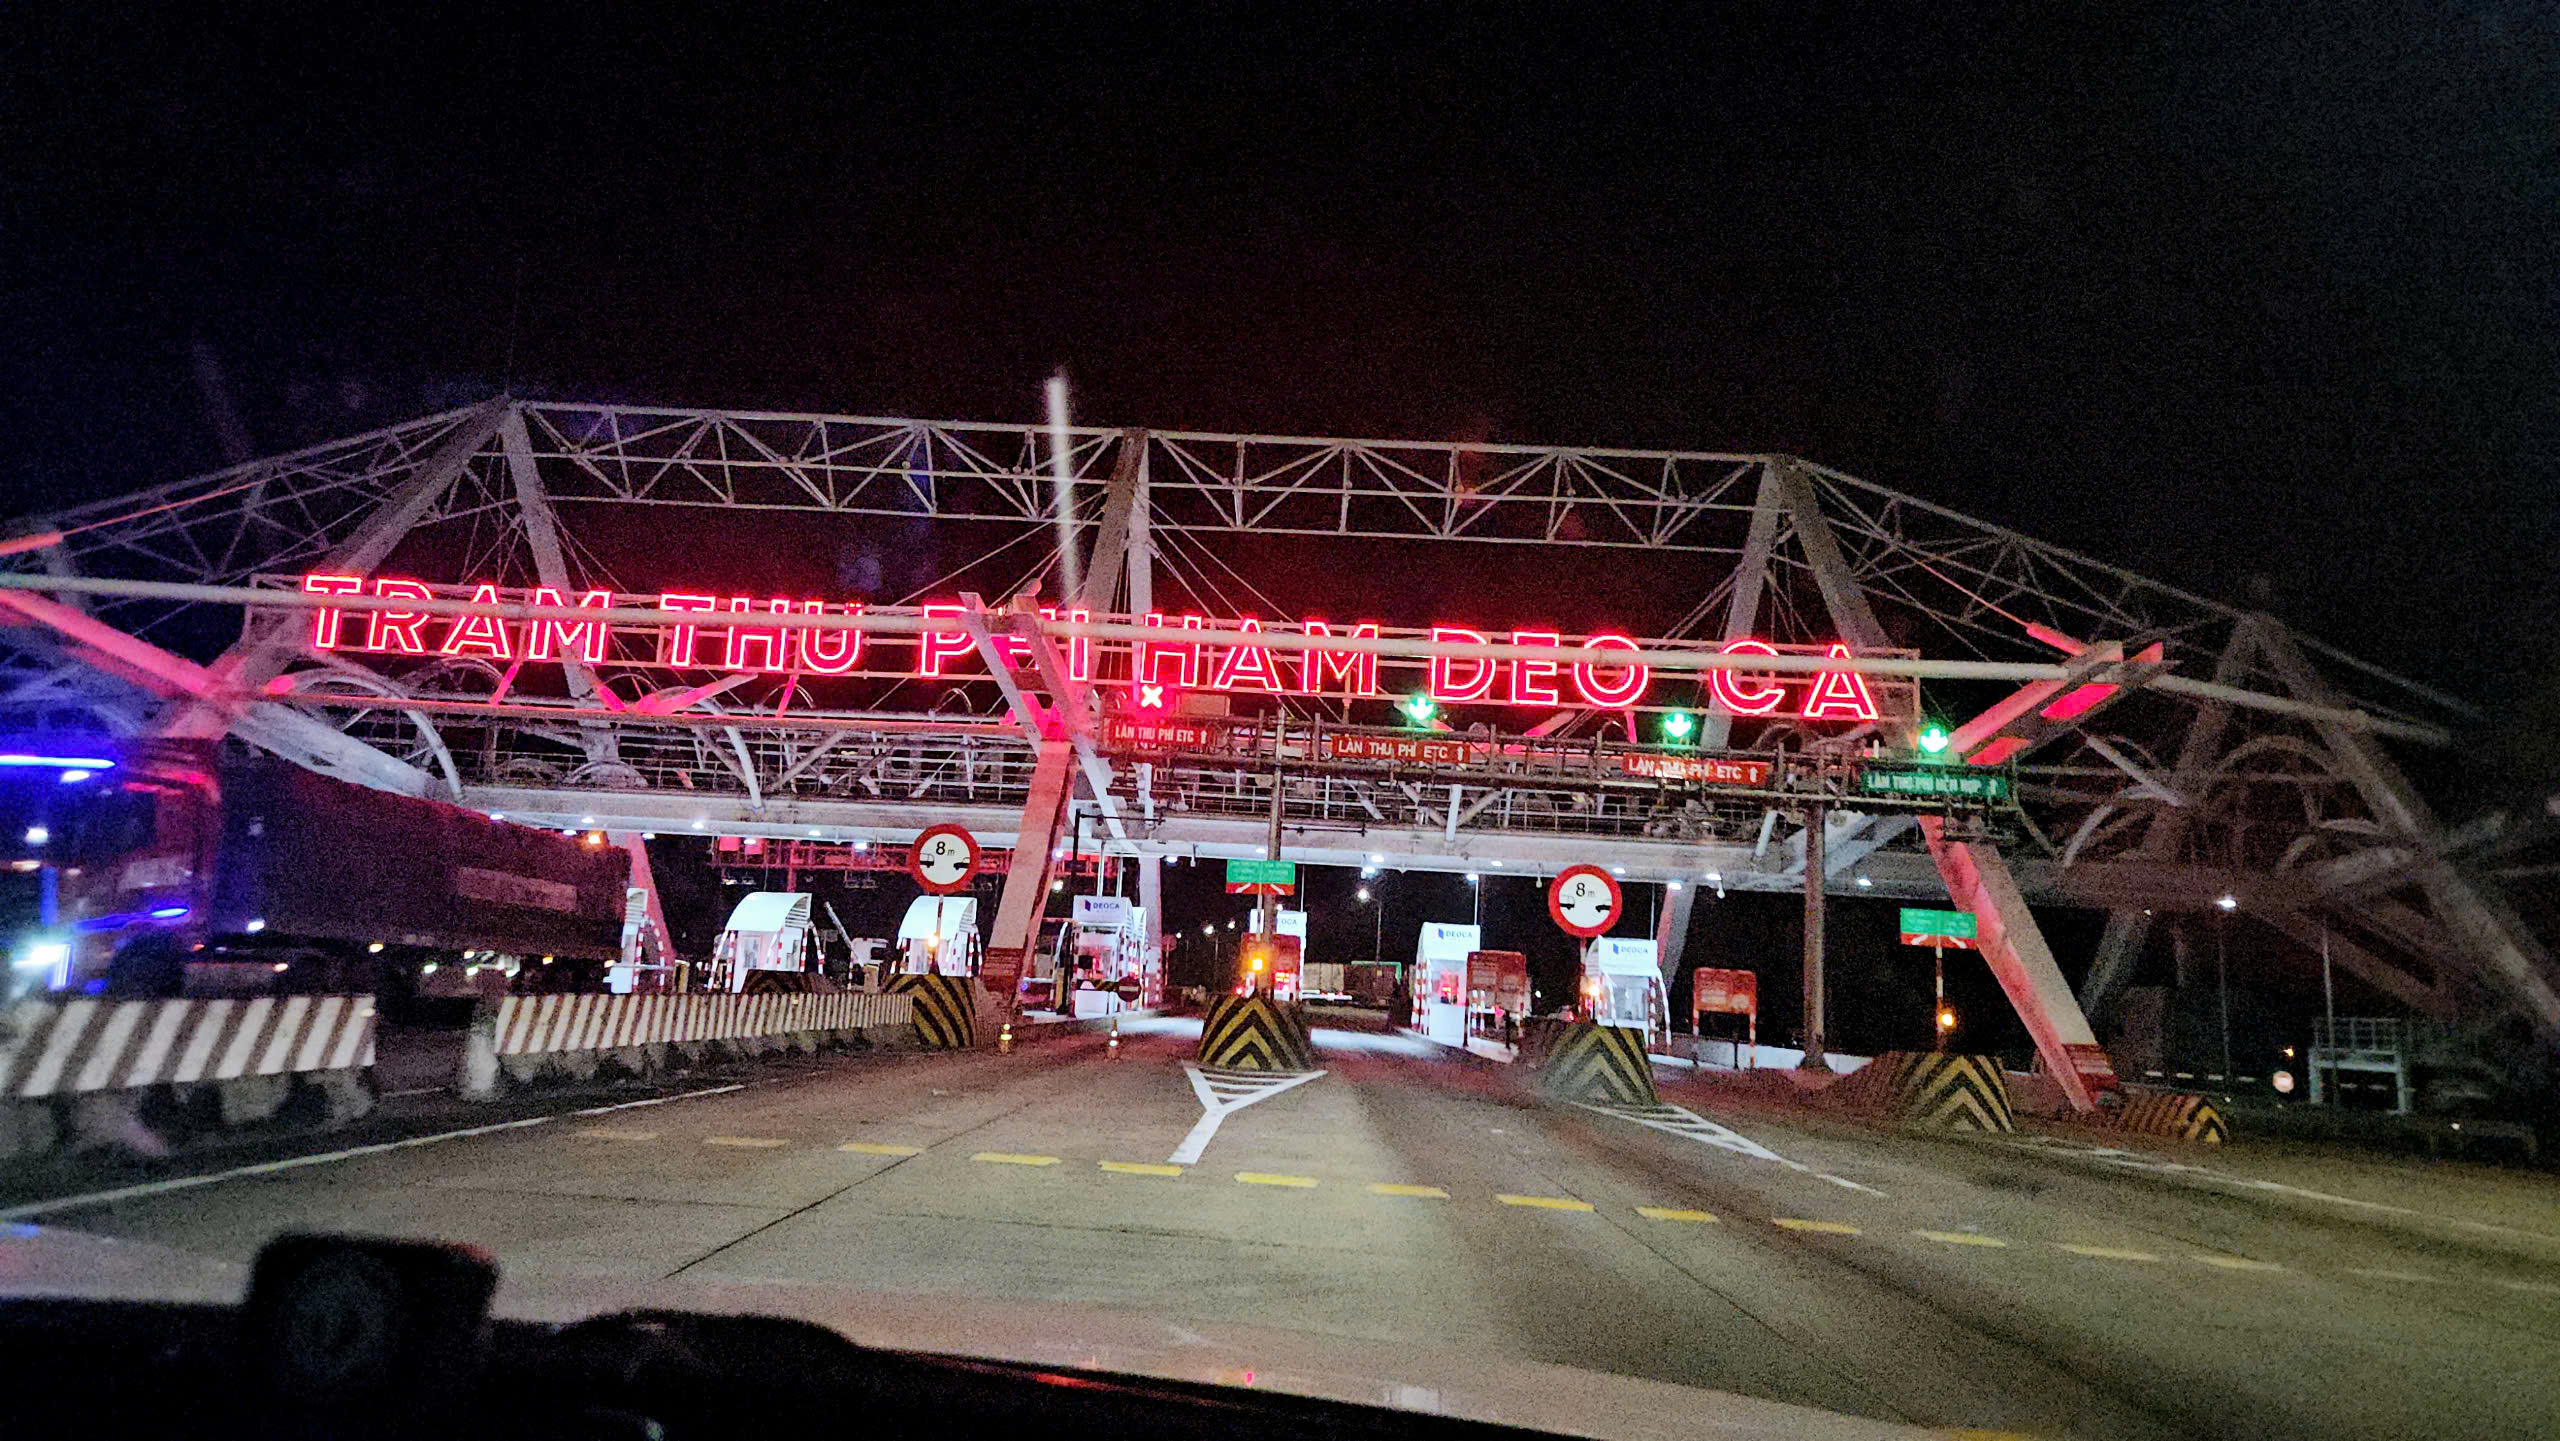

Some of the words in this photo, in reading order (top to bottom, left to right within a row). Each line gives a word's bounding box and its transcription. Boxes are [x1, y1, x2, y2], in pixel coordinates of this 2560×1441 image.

[305, 574, 612, 664] TRAM
[658, 593, 863, 674] THU
[920, 604, 1090, 681] PI
[1139, 612, 1379, 696] HAM
[1429, 627, 1649, 709] DEO
[1711, 640, 1880, 720] CA
[1176, 729, 1194, 742] ETC
[1717, 765, 1742, 780] ETC
[936, 841, 945, 855] 8
[1576, 882, 1585, 897] 8
